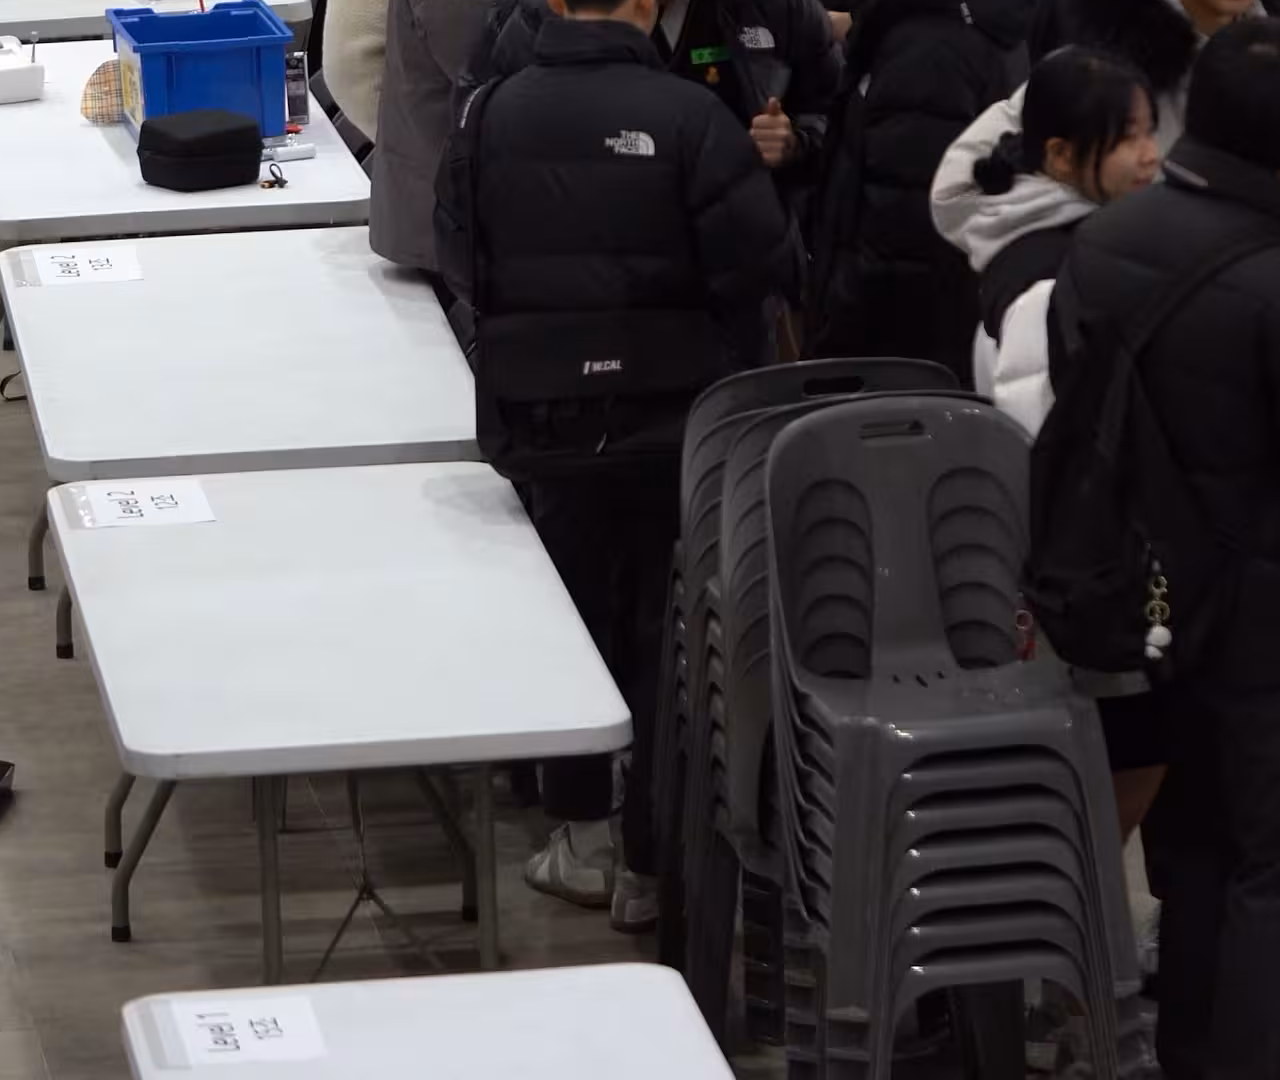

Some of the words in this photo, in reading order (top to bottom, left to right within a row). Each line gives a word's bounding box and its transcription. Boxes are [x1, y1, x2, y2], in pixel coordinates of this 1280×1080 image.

[51, 261, 81, 277] Level
[107, 498, 145, 519] Level
[197, 1022, 241, 1053] Level
